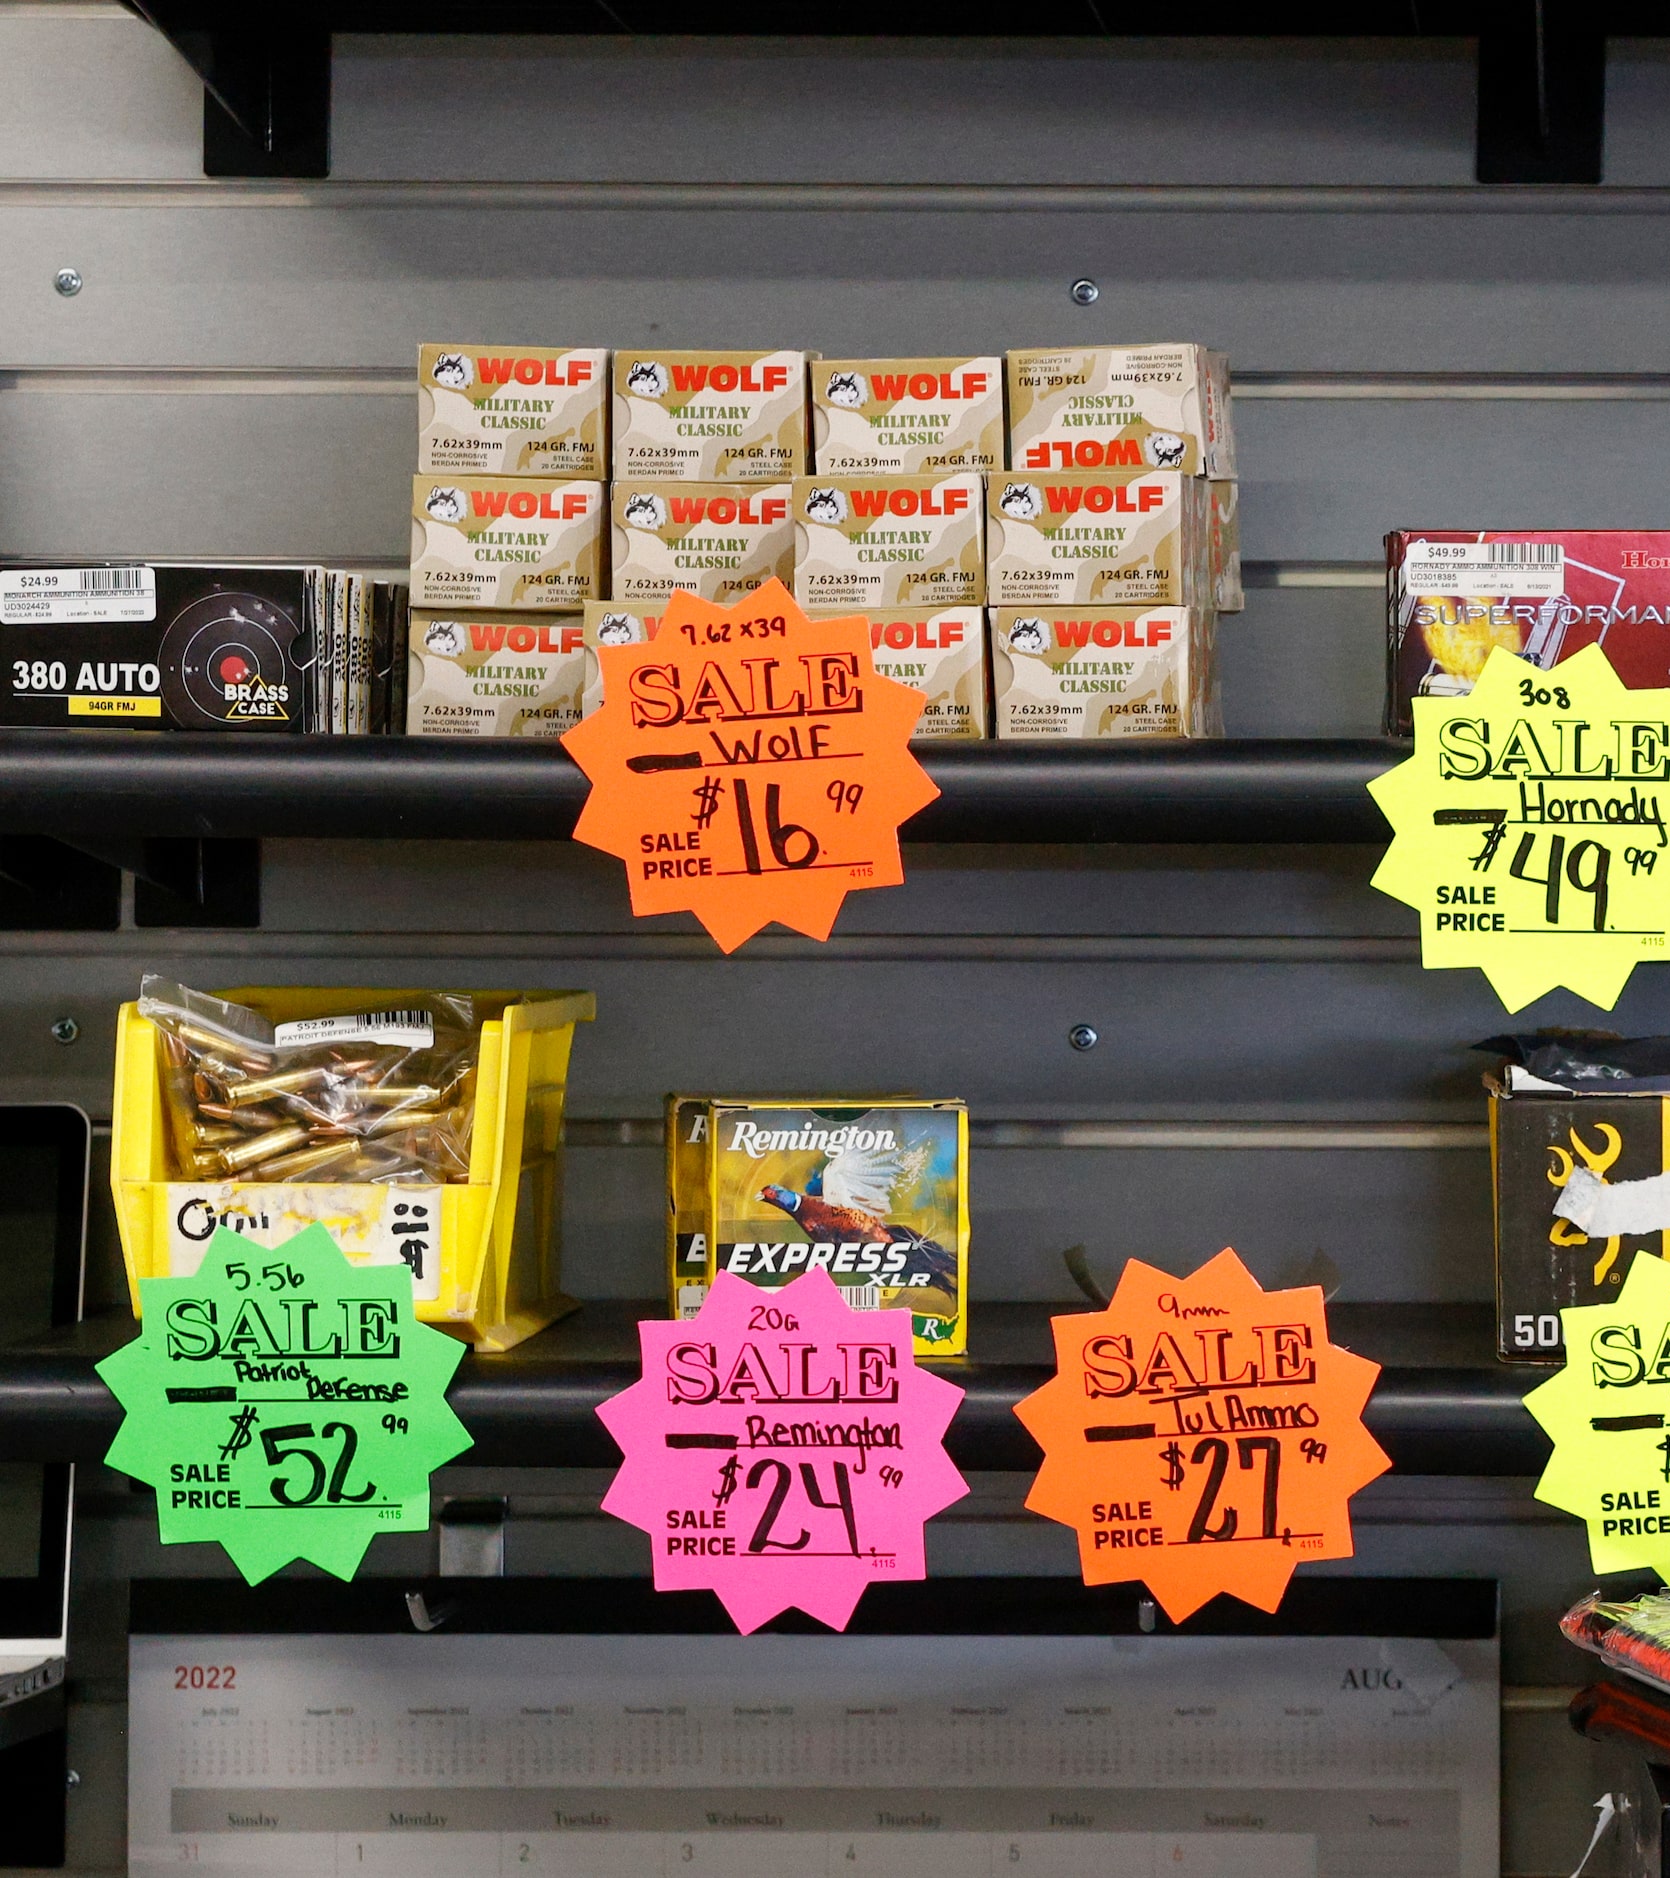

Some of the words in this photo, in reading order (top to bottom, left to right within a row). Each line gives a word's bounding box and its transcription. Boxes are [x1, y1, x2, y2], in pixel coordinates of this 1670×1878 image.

[476, 358, 593, 386] WOLF
[671, 364, 788, 393] WOLF
[870, 373, 987, 402] WOLF
[474, 398, 555, 413] MILITARY
[481, 416, 546, 430] CLASSIC
[431, 438, 503, 450] 7.62x39mm
[527, 440, 547, 452] 124
[550, 442, 571, 453] GR.
[573, 442, 596, 454] FMJ
[1025, 439, 1143, 469] WOLF
[470, 491, 587, 519] WOLF
[850, 489, 968, 517] WOLF
[1045, 485, 1163, 514] WOLF
[670, 497, 787, 525] WOLF
[1428, 547, 1466, 558] $49.99
[20, 576, 58, 588] $24.99
[4, 602, 51, 611] UD3024429
[470, 625, 584, 654] WOLF
[1054, 620, 1172, 648] WOLF
[12, 661, 67, 691] 380
[75, 662, 161, 692] AUTO
[224, 684, 289, 702] BRASS
[629, 652, 864, 729] SALE
[1518, 679, 1571, 709] 308
[88, 701, 114, 712] 94GR
[116, 702, 137, 712] FMJ
[238, 702, 275, 715] CASE
[1439, 718, 1670, 782] SALE
[1520, 782, 1668, 848] Hornady
[640, 831, 701, 853] SALE
[643, 857, 712, 880] PRICE
[849, 867, 874, 877] 4115
[1436, 886, 1496, 905] SALE
[1436, 912, 1505, 932] PRICE
[1641, 937, 1665, 946] 4115
[296, 1019, 335, 1031] $52.99
[727, 1121, 899, 1159] Remington
[727, 1243, 914, 1273] EXPRESS
[225, 1262, 305, 1292] 5.56
[864, 1273, 931, 1287] XLR
[166, 1298, 400, 1360] SALE
[1082, 1323, 1316, 1399] SALE
[666, 1342, 900, 1405] SALE
[746, 1415, 904, 1475] Remington
[170, 1464, 230, 1483] SALE
[172, 1490, 241, 1509] PRICE
[1600, 1490, 1661, 1512] SALE
[378, 1510, 402, 1519] 4115
[667, 1510, 726, 1529] SALE
[1092, 1501, 1152, 1523] SALE
[667, 1537, 736, 1556] PRICE
[1094, 1527, 1164, 1550] PRICE
[1300, 1539, 1324, 1549] 4115
[871, 1559, 896, 1569] 4115
[173, 1666, 236, 1689] 2022
[226, 1812, 280, 1830] Sunday
[389, 1812, 448, 1830] Monday
[706, 1812, 784, 1830] Wednesday
